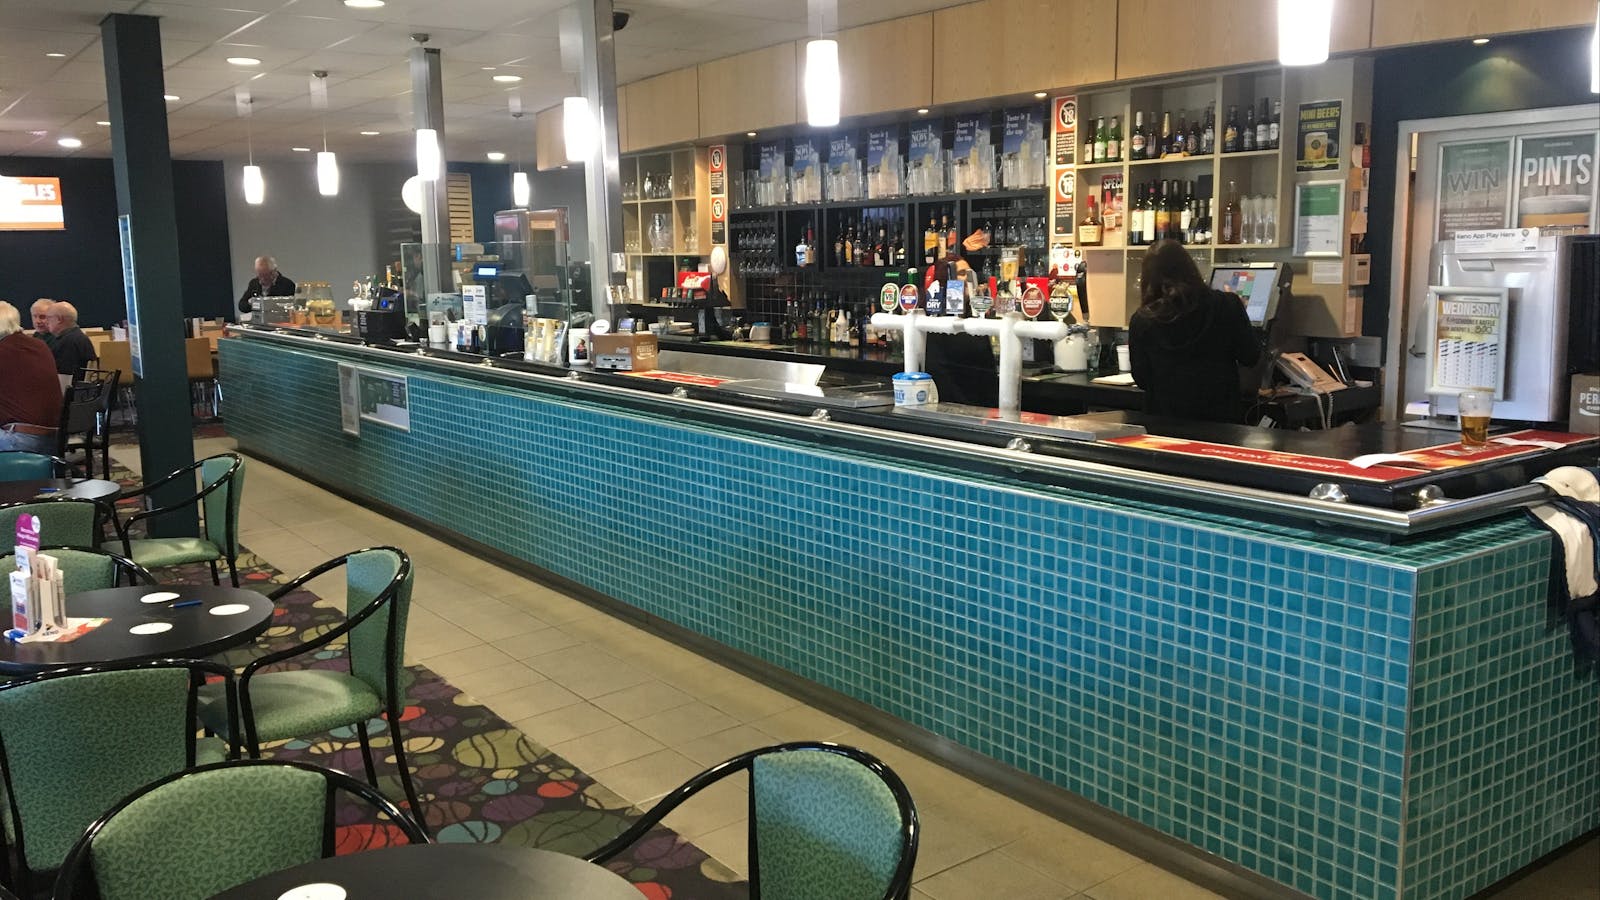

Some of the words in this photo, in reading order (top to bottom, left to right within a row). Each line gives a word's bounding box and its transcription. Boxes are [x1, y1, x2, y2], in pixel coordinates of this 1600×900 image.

[1317, 107, 1340, 118] BEERS
[1523, 153, 1592, 187] PINTS
[1448, 167, 1500, 193] WIN
[1472, 232, 1485, 240] App
[926, 301, 941, 309] DRY
[1442, 302, 1500, 316] WEDNESDAY
